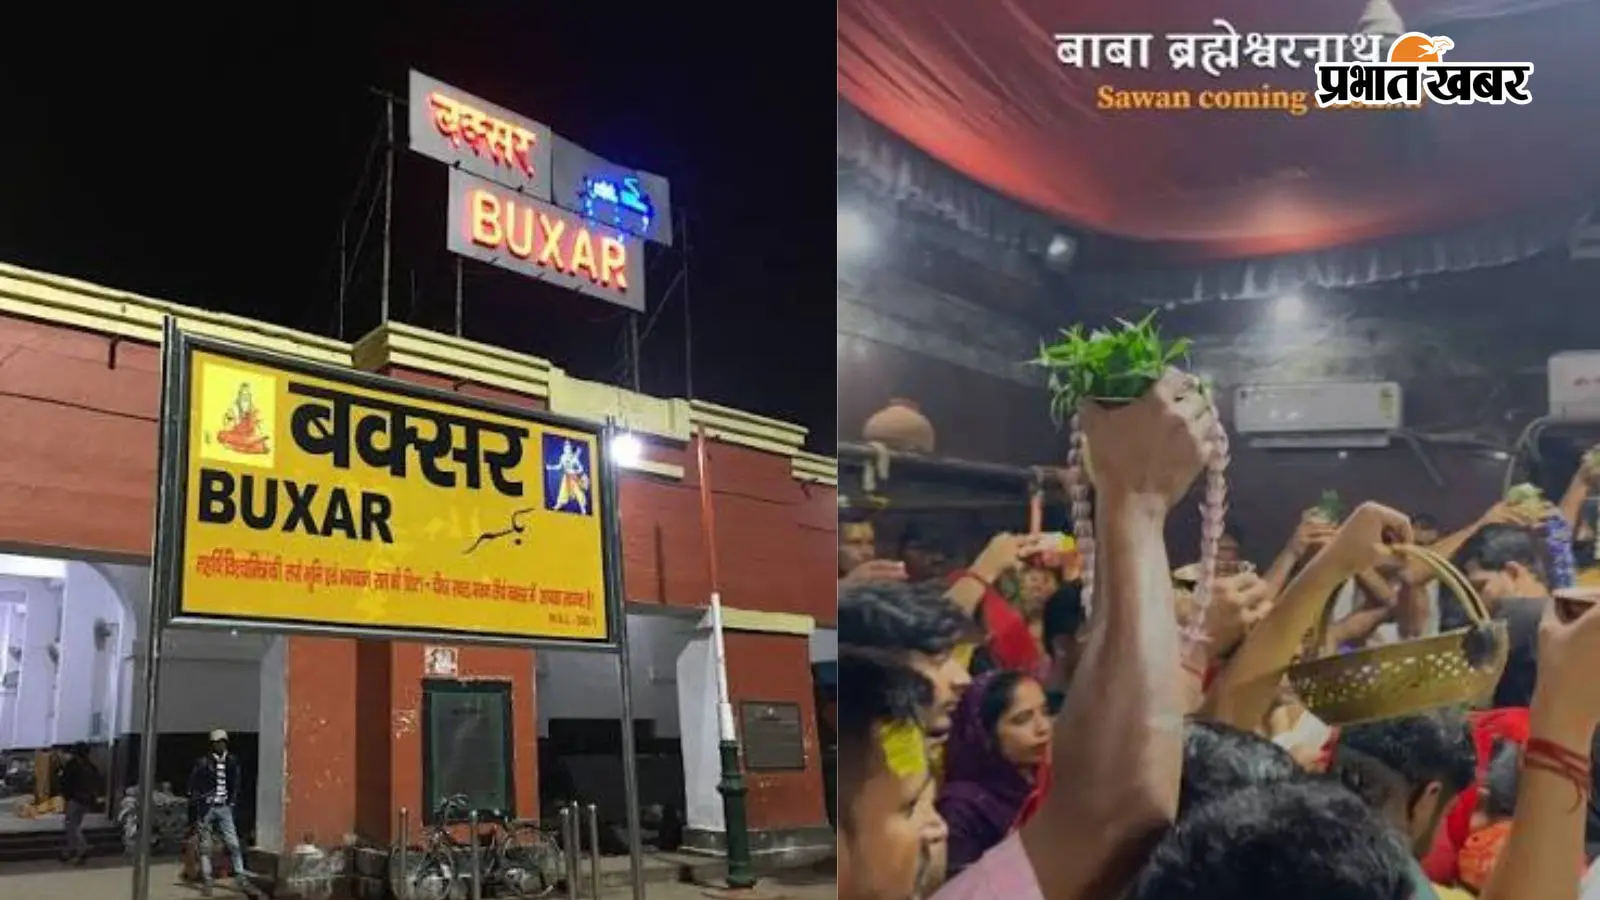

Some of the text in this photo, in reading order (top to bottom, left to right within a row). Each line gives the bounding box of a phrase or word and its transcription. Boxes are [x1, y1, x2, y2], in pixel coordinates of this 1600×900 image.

[471, 189, 628, 293] BUXAR
[287, 381, 529, 497] बक्सर
[198, 468, 394, 543] BUXAR
